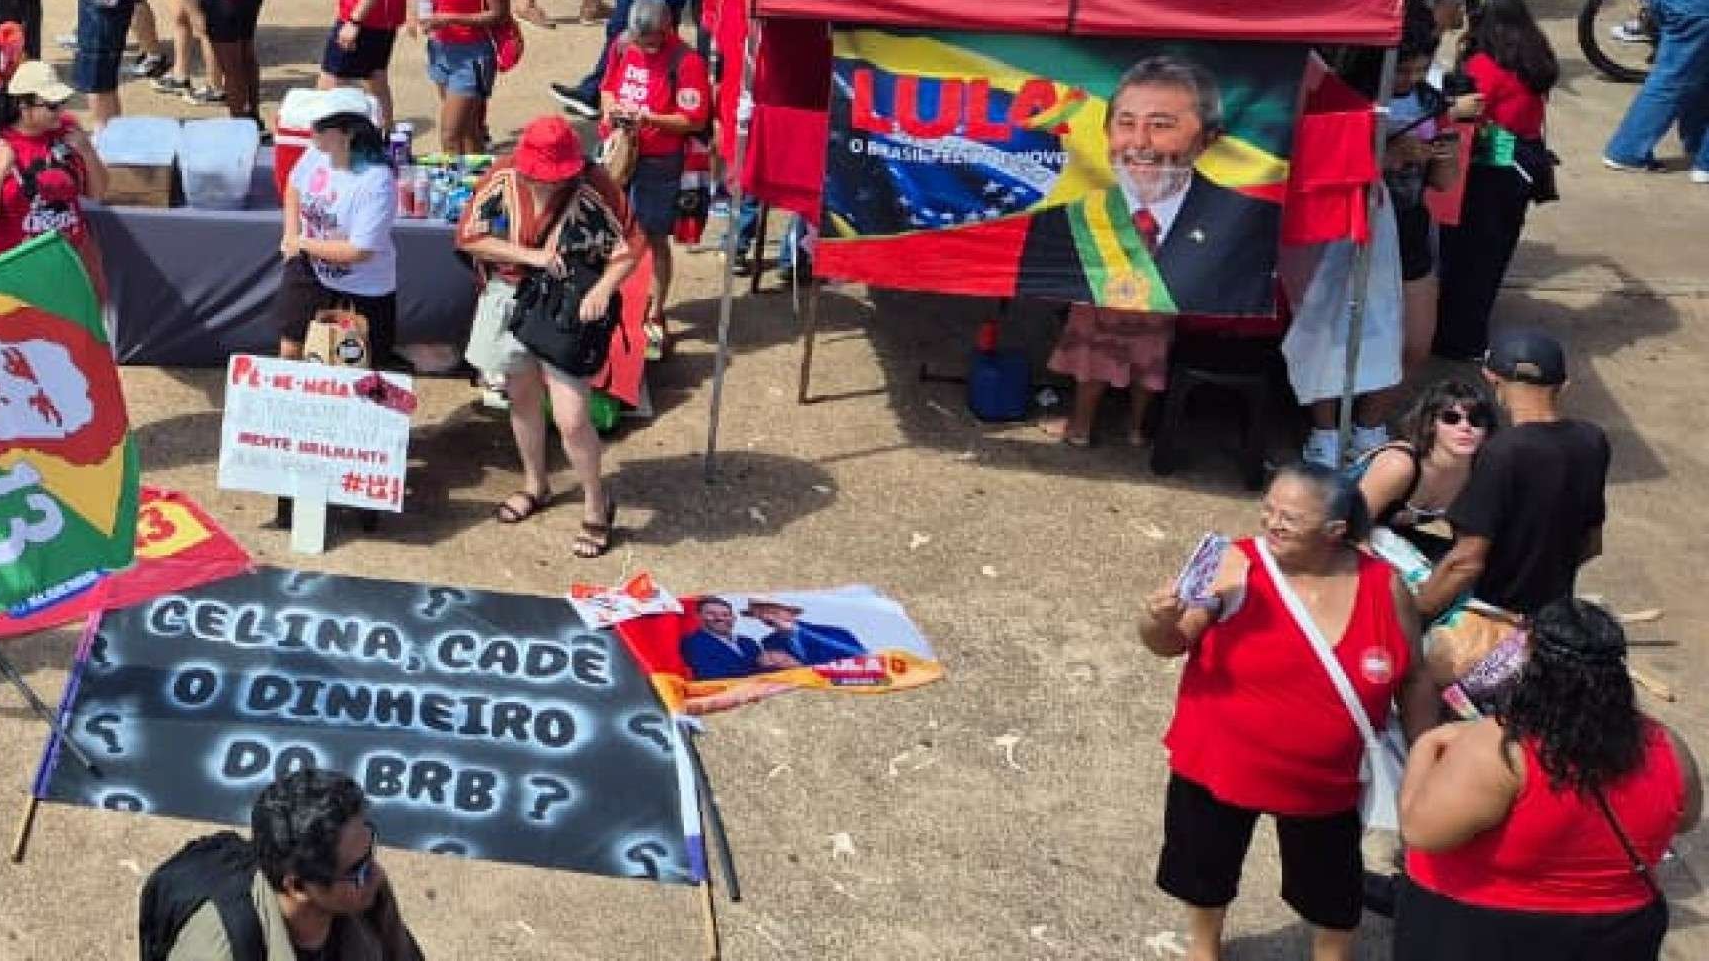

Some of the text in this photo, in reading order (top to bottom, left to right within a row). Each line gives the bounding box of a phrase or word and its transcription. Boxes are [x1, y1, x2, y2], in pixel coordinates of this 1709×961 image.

[852, 69, 1086, 141] LULA
[137, 505, 178, 545] 3
[149, 597, 423, 671] CELINA,
[173, 669, 578, 748] O DINHEIRO
[364, 756, 498, 813] BRB
